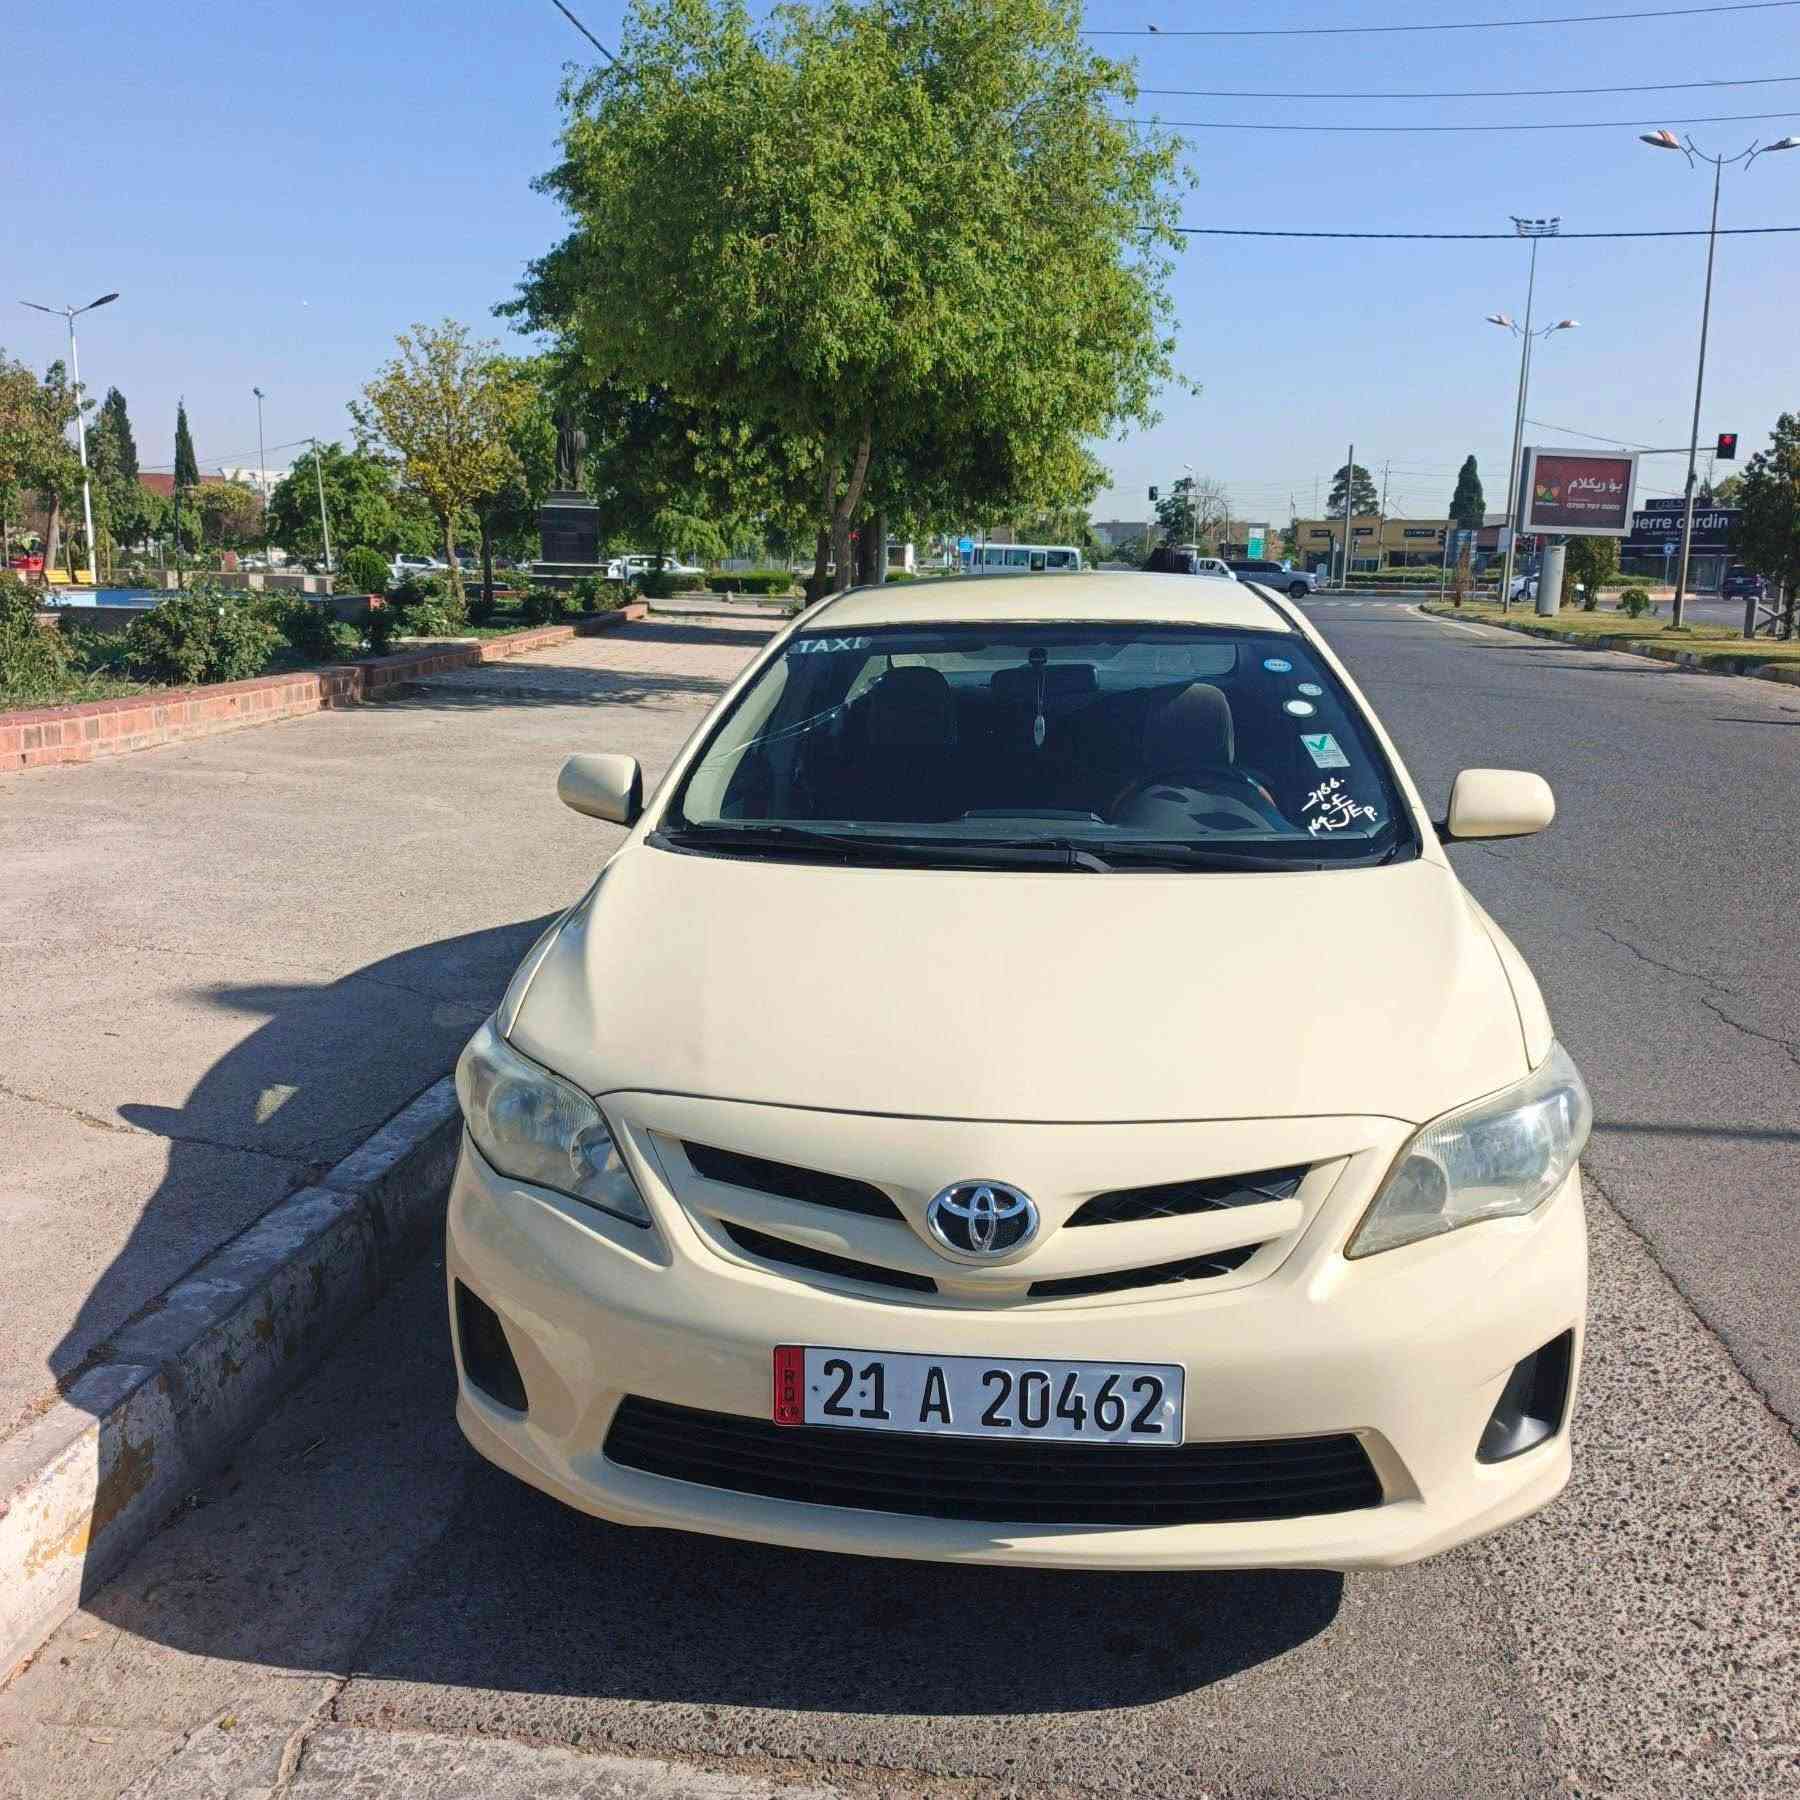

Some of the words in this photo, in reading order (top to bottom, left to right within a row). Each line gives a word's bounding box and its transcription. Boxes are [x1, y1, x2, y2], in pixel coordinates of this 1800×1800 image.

[799, 636, 866, 653] TAXI
[823, 1359, 891, 1420] 21
[919, 1365, 951, 1425] A
[980, 1369, 1164, 1434] 20462
